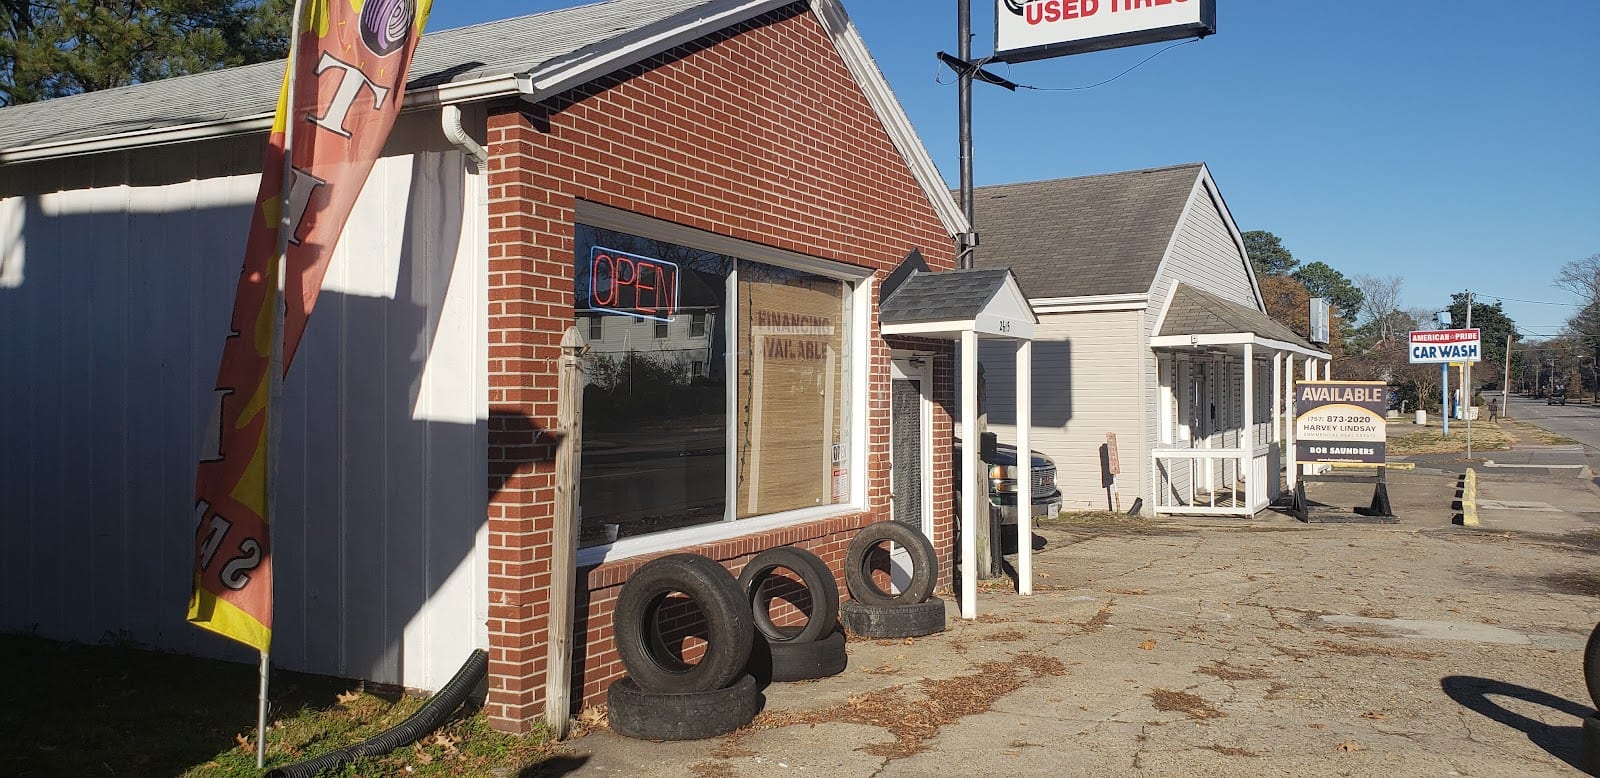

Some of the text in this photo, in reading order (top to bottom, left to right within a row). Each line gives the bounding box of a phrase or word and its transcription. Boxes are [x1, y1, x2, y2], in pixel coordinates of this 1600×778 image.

[1026, 0, 1100, 26] USED
[593, 253, 676, 316] OPEN
[1412, 332, 1477, 342] AMERICAN PRIDE
[1413, 345, 1477, 359] CAR WASH
[1301, 387, 1382, 402] AVAILABLE
[1326, 415, 1371, 423] 873-2020
[1309, 446, 1374, 455] BOB SAUNDERS
